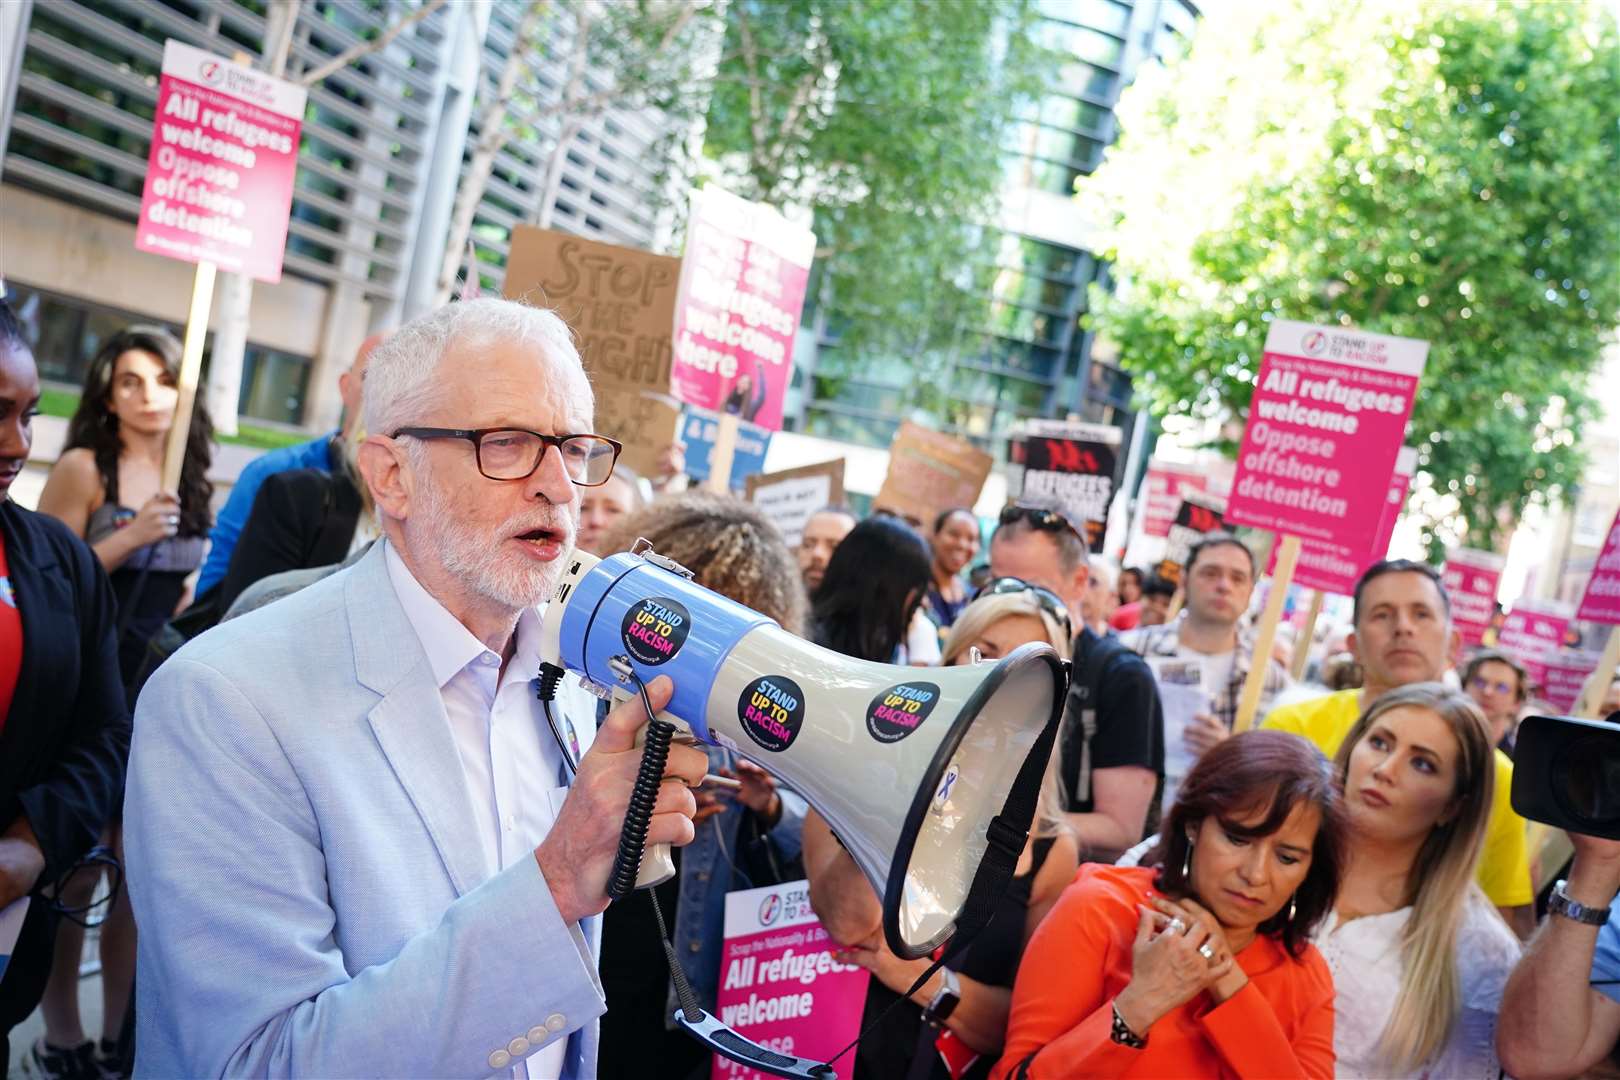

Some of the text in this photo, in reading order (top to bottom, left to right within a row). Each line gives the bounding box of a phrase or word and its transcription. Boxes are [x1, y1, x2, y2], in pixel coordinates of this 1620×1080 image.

[164, 92, 199, 122] All
[201, 108, 292, 153] refugees
[161, 123, 256, 168] welcome
[157, 146, 240, 190] Oppose
[152, 176, 245, 218] offshore
[148, 200, 253, 247] detention
[541, 240, 670, 306] STOP
[685, 305, 785, 365] welcome
[677, 331, 738, 378] here
[1262, 368, 1406, 416] All refugees
[1258, 399, 1358, 435] welcome
[1251, 423, 1336, 458] Oppose
[1024, 468, 1112, 501] REFUGEES
[1244, 452, 1342, 487] offshore
[1237, 476, 1348, 517] detention
[636, 610, 673, 637] UP TO
[643, 599, 683, 627] STAND
[628, 621, 674, 656] RACISM
[751, 692, 788, 724] UP TO
[757, 680, 798, 712] STAND
[884, 694, 921, 714] UP TO
[893, 685, 933, 703] STAND
[745, 704, 790, 743] RACISM
[874, 704, 921, 729] RACISM
[785, 890, 810, 905] STA
[724, 956, 757, 990] All
[722, 992, 814, 1028] welcome
